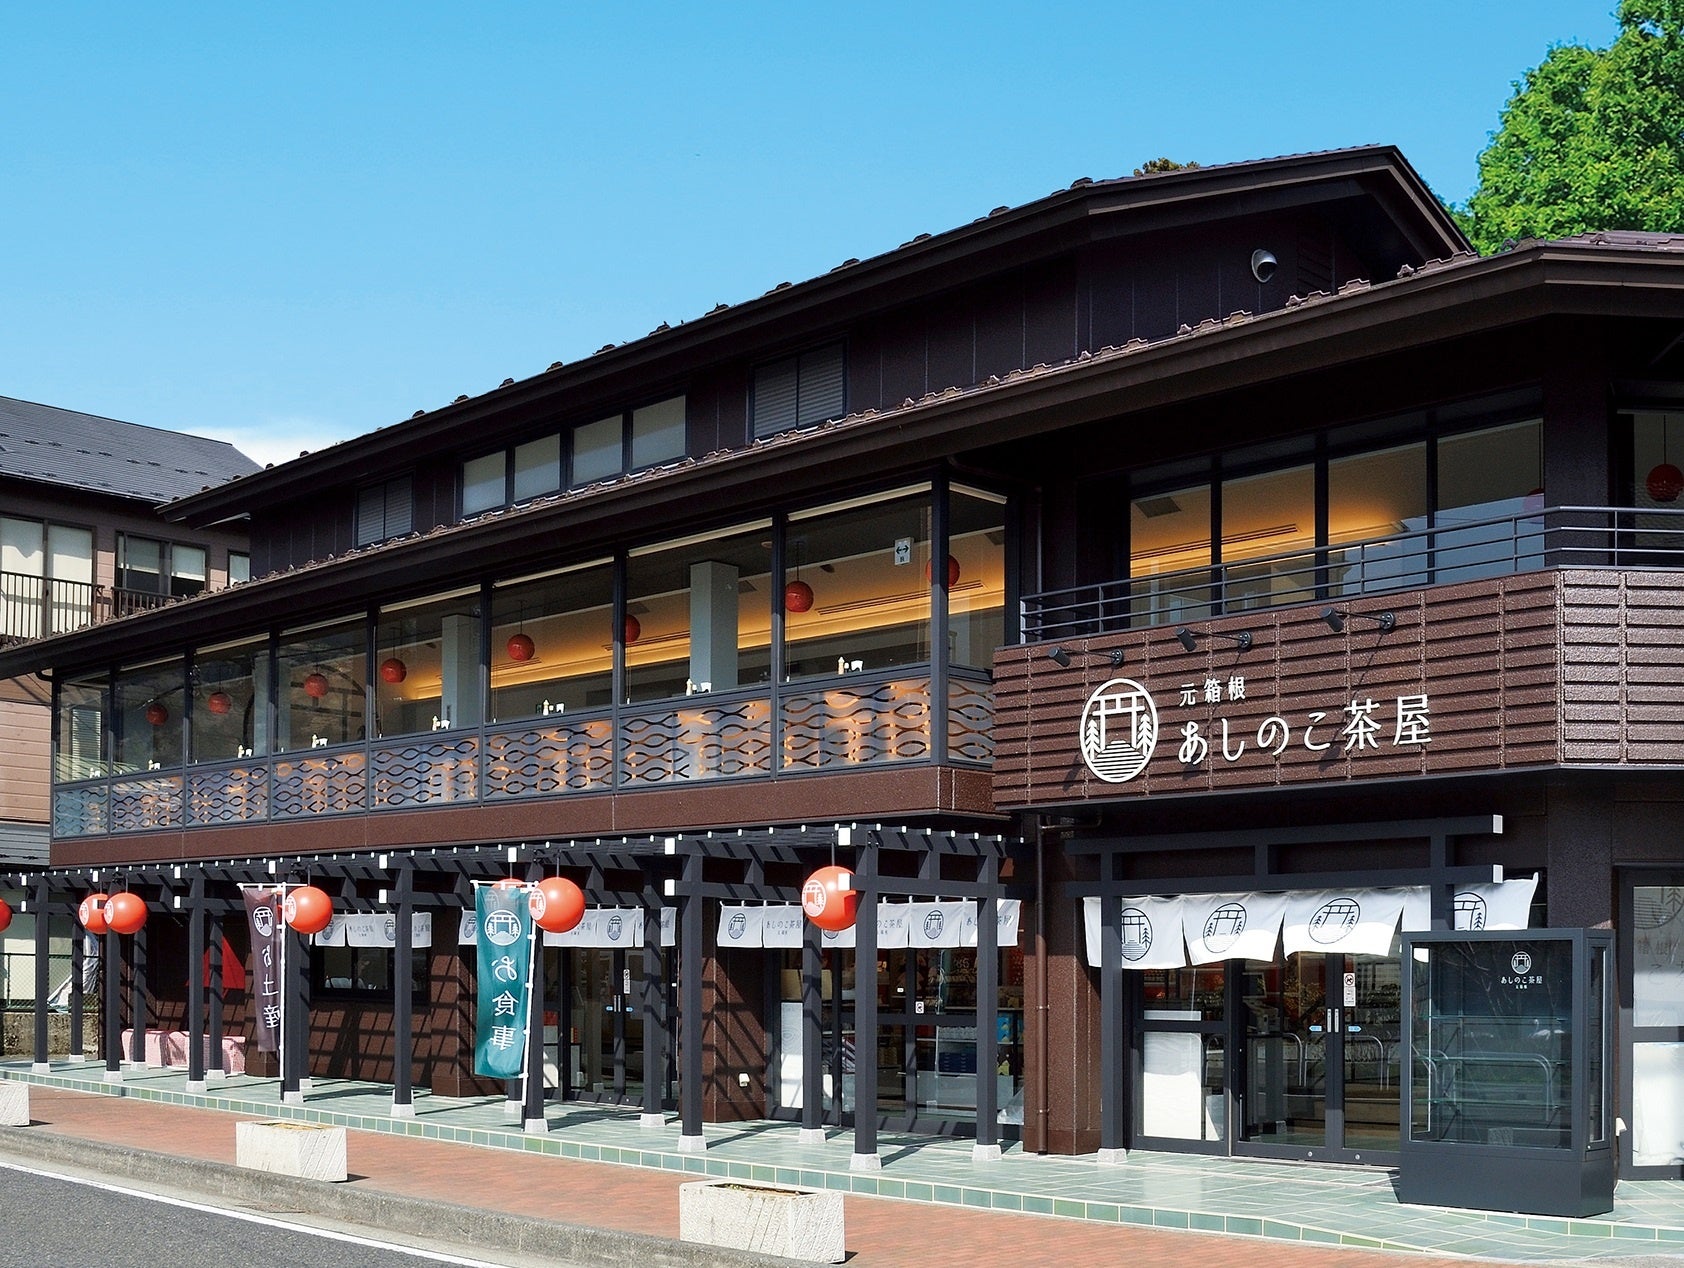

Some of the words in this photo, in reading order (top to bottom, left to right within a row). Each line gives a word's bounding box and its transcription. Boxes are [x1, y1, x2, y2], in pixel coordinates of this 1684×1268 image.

[1179, 676, 1246, 707] 元箱根
[1178, 693, 1433, 765] あしのこ茶屋
[1500, 976, 1543, 984] あしのこ茶屋
